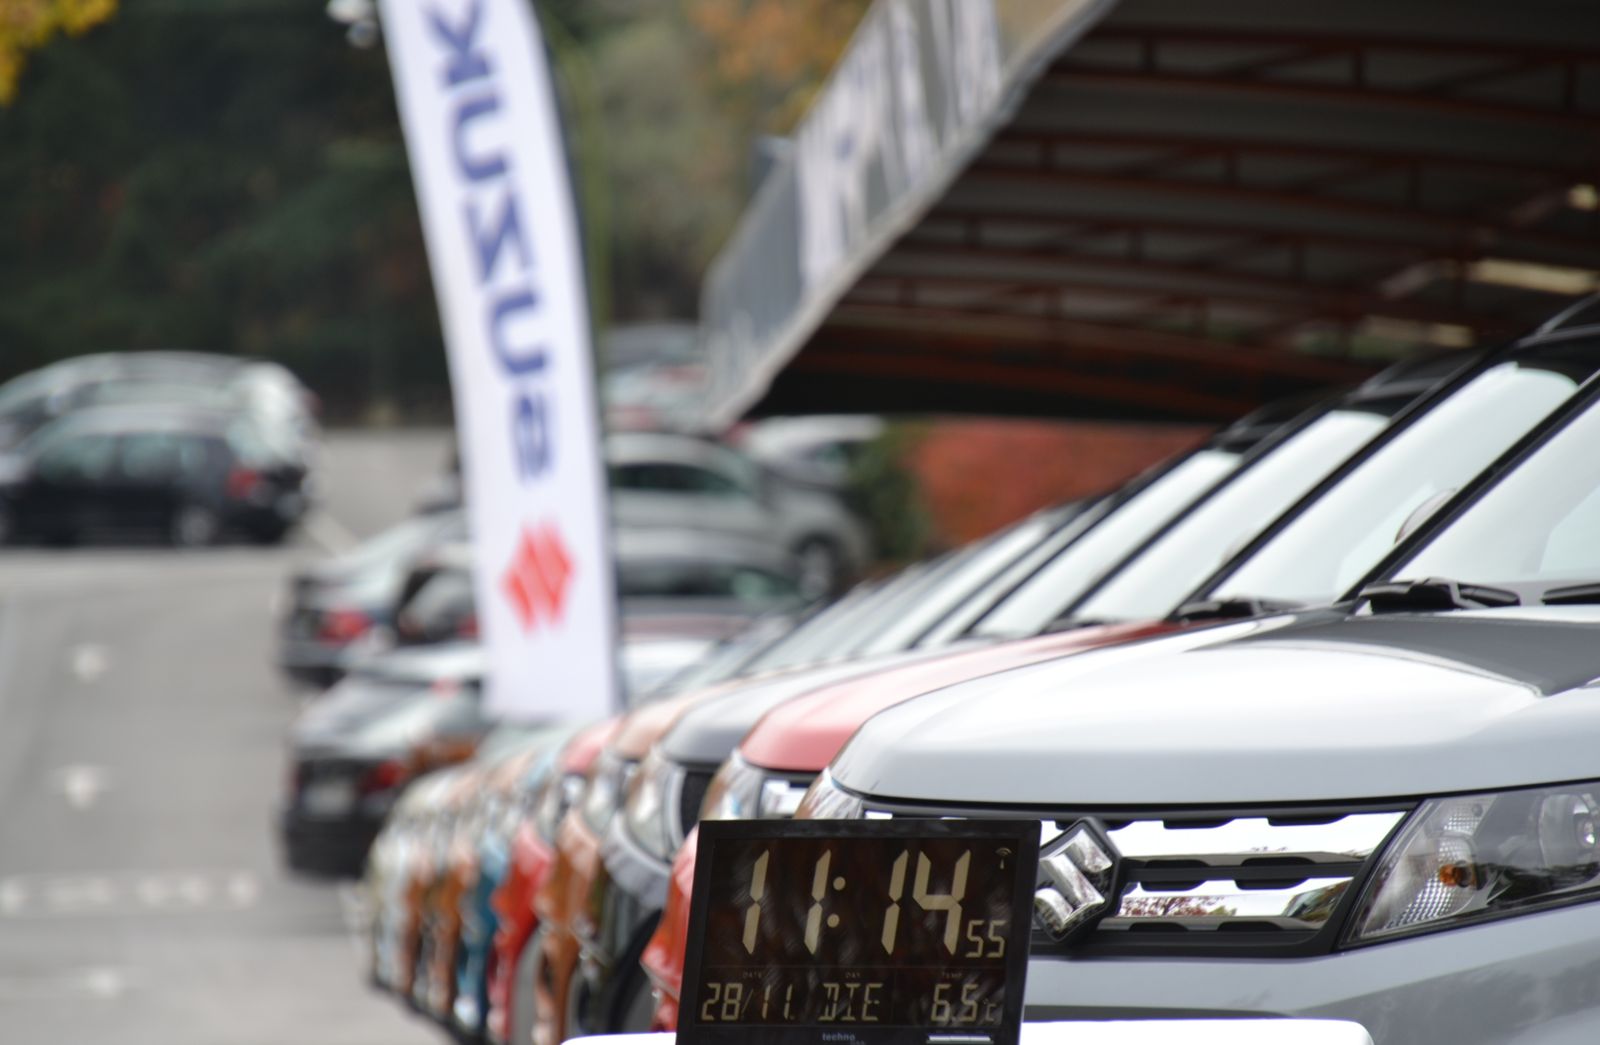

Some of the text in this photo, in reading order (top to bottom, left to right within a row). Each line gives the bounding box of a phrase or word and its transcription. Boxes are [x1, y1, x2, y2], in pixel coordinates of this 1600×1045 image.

[743, 849, 1006, 958] 11:14 55
[818, 983, 884, 1021] DIE
[822, 1033, 856, 1042] techno
